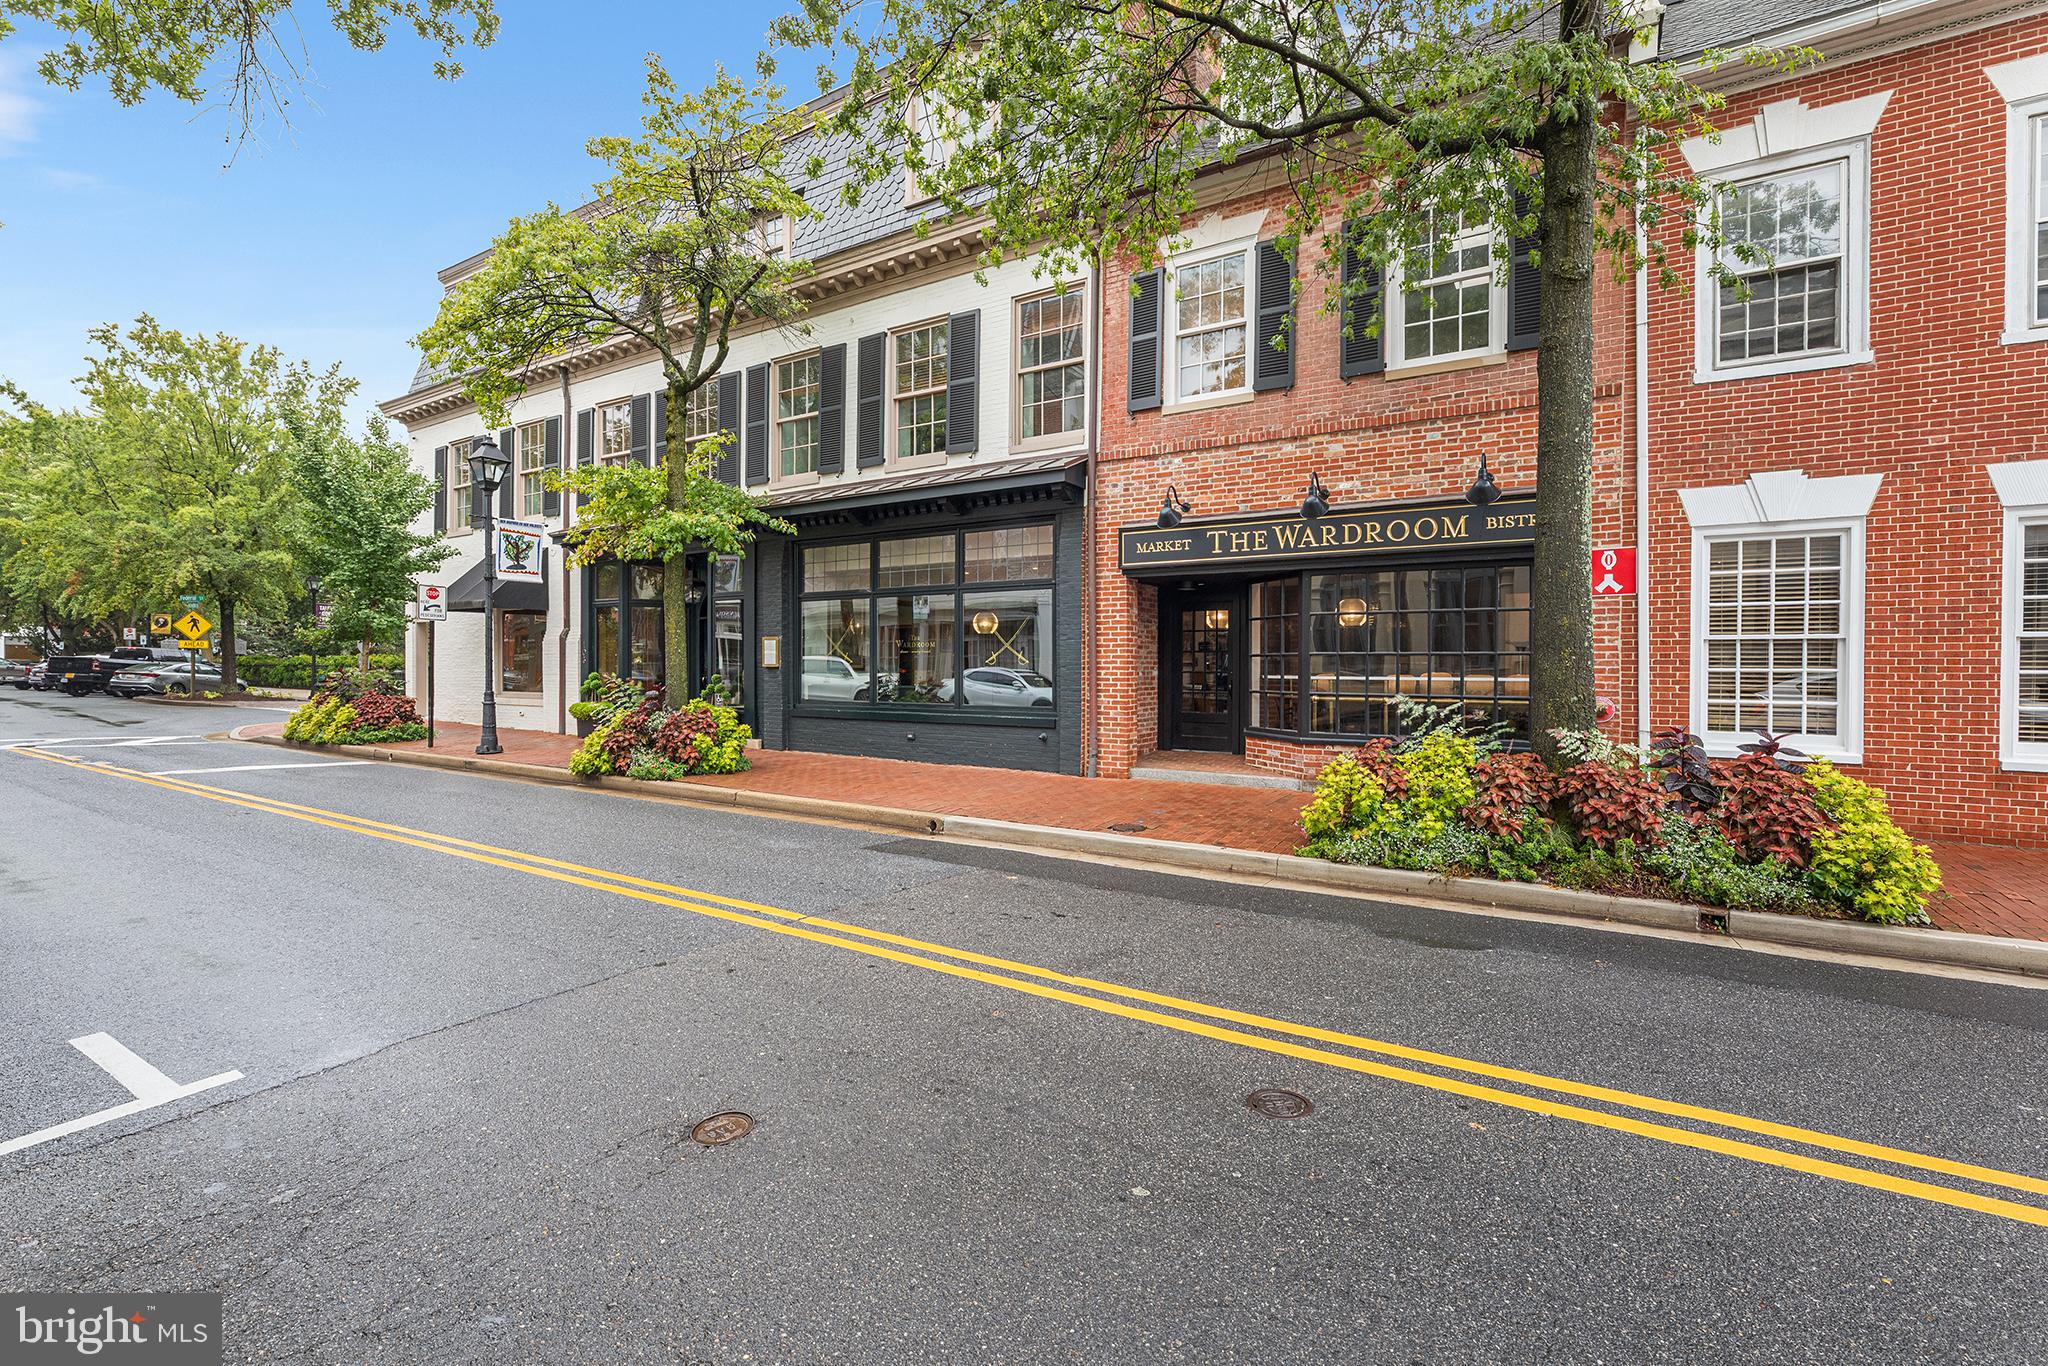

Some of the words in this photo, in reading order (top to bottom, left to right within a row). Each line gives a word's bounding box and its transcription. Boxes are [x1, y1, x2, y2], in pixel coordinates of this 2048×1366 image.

[1486, 513, 1537, 530] BISTR
[1206, 529, 1268, 554] THE
[1272, 514, 1469, 550] WARDROOM
[1136, 539, 1192, 554] MARKET
